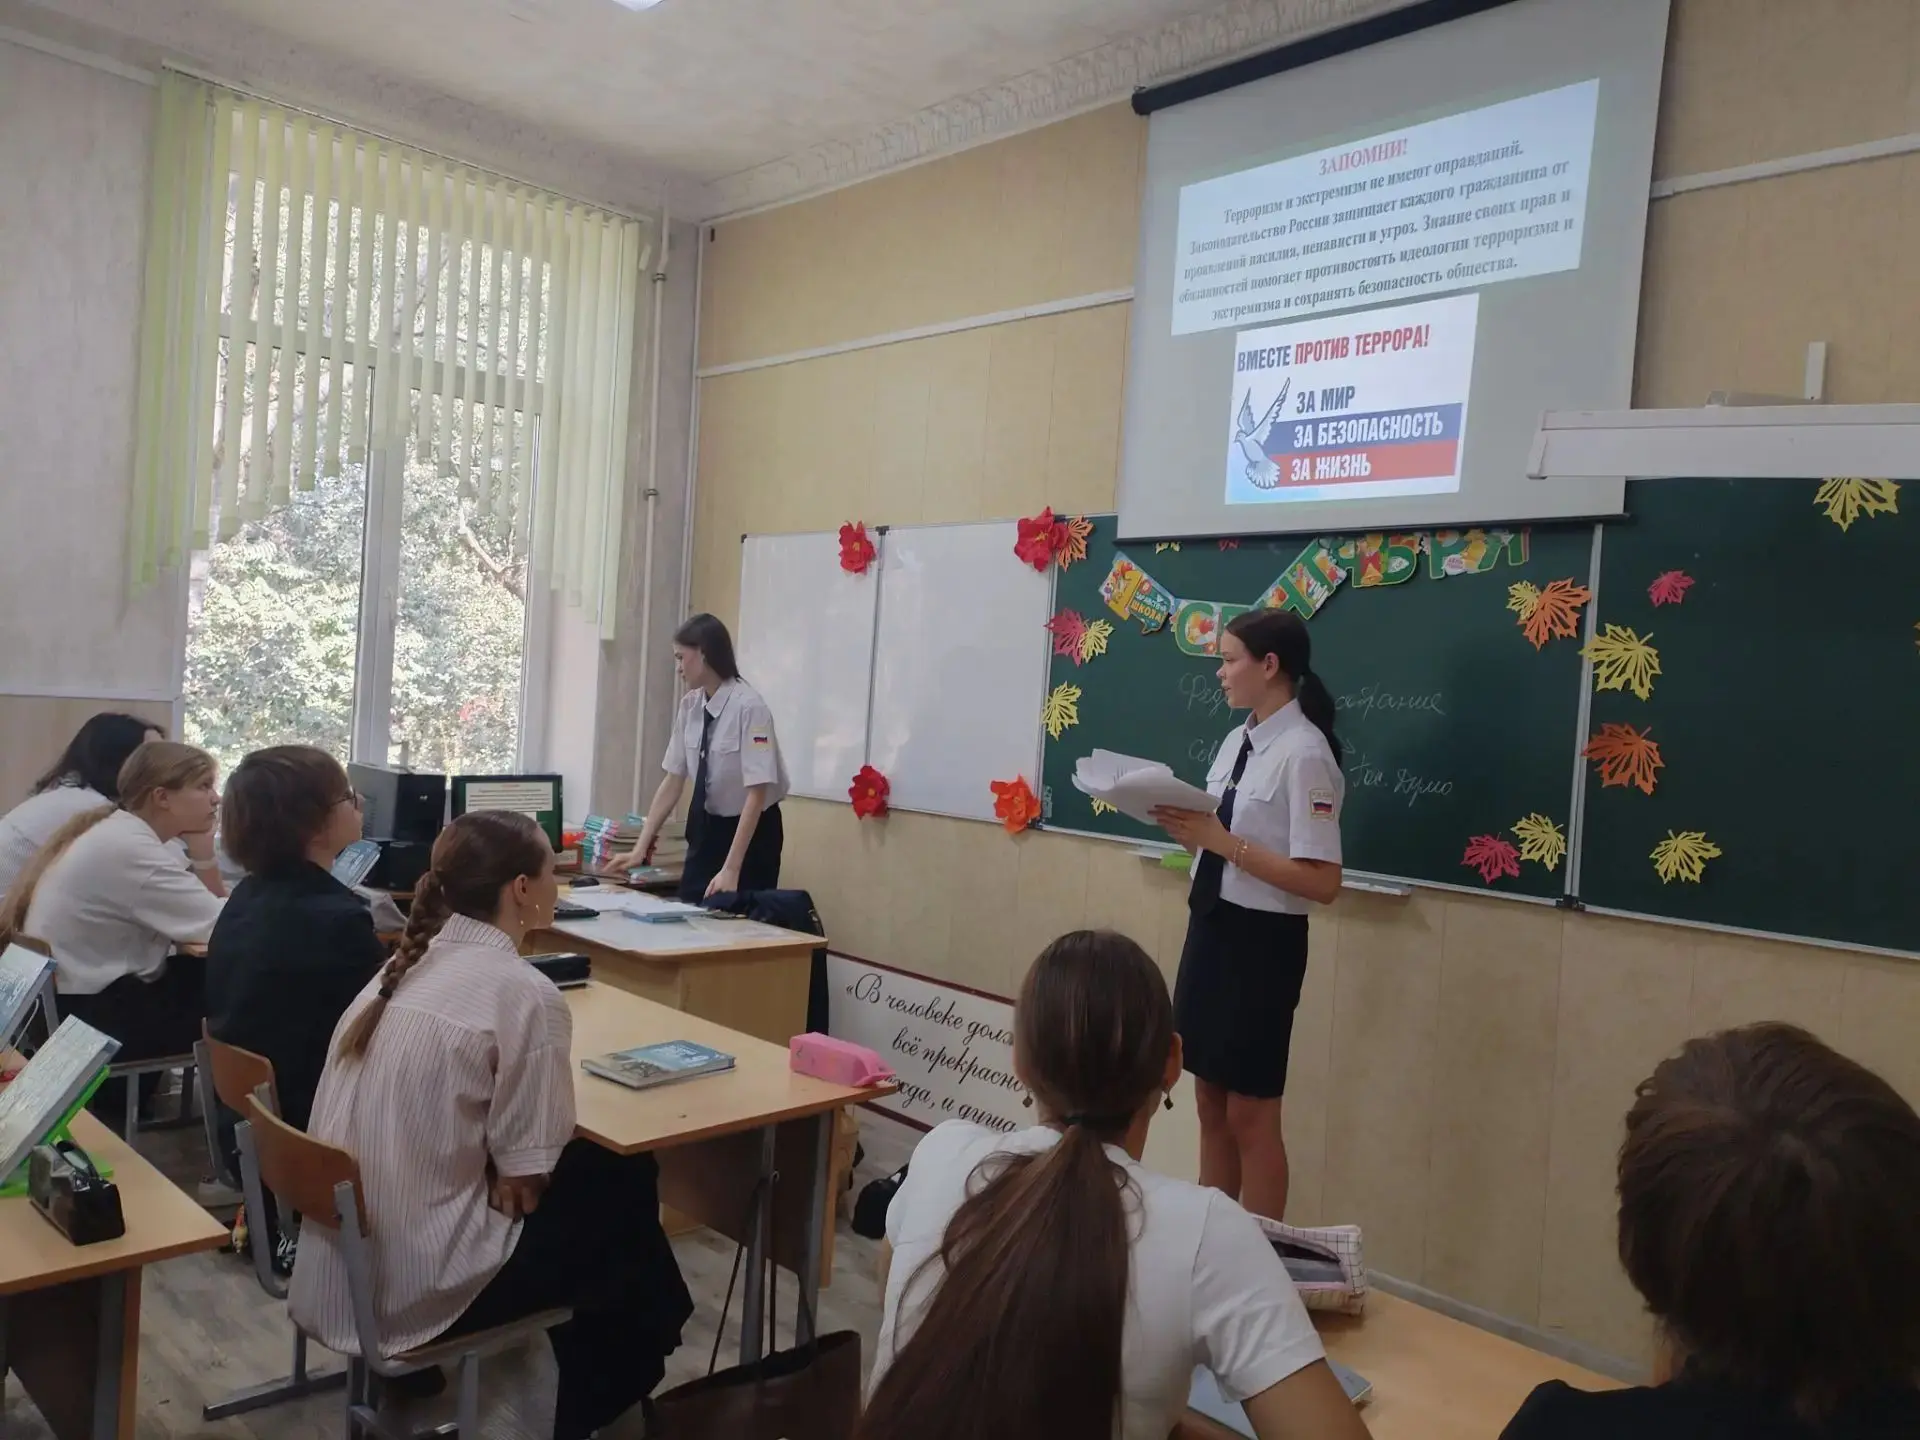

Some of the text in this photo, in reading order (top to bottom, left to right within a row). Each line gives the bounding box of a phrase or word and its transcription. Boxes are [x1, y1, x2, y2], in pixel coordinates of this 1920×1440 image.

[1319, 138, 1408, 176] ЗАПОМНИ!
[1224, 140, 1524, 225] Терроризм и экстремизм не имеют оправданий.
[1190, 161, 1570, 255] Законодательство России защищает каждого гражданина от
[1184, 189, 1571, 282] проявлений насилия, ненависти и угроз. Знание своих прав и
[1179, 217, 1574, 304] обязанностей помогает противостоять идеологии терроризма и
[1211, 257, 1518, 321] экстремизма и сохранять безопасность общества.
[1237, 324, 1430, 372] ВМЕСТЕ ПРОТИВ ТЕРРОРА!
[1296, 385, 1355, 414] ЗА МИР
[1294, 412, 1443, 448] ЗА БЕЗОПАСНОСТЬ
[1291, 453, 1371, 482] ЗА ЖИЗНЬ
[885, 996, 963, 1029] человеке
[963, 1021, 1014, 1047] долж
[892, 1027, 921, 1056] всё
[941, 1097, 954, 1112] и
